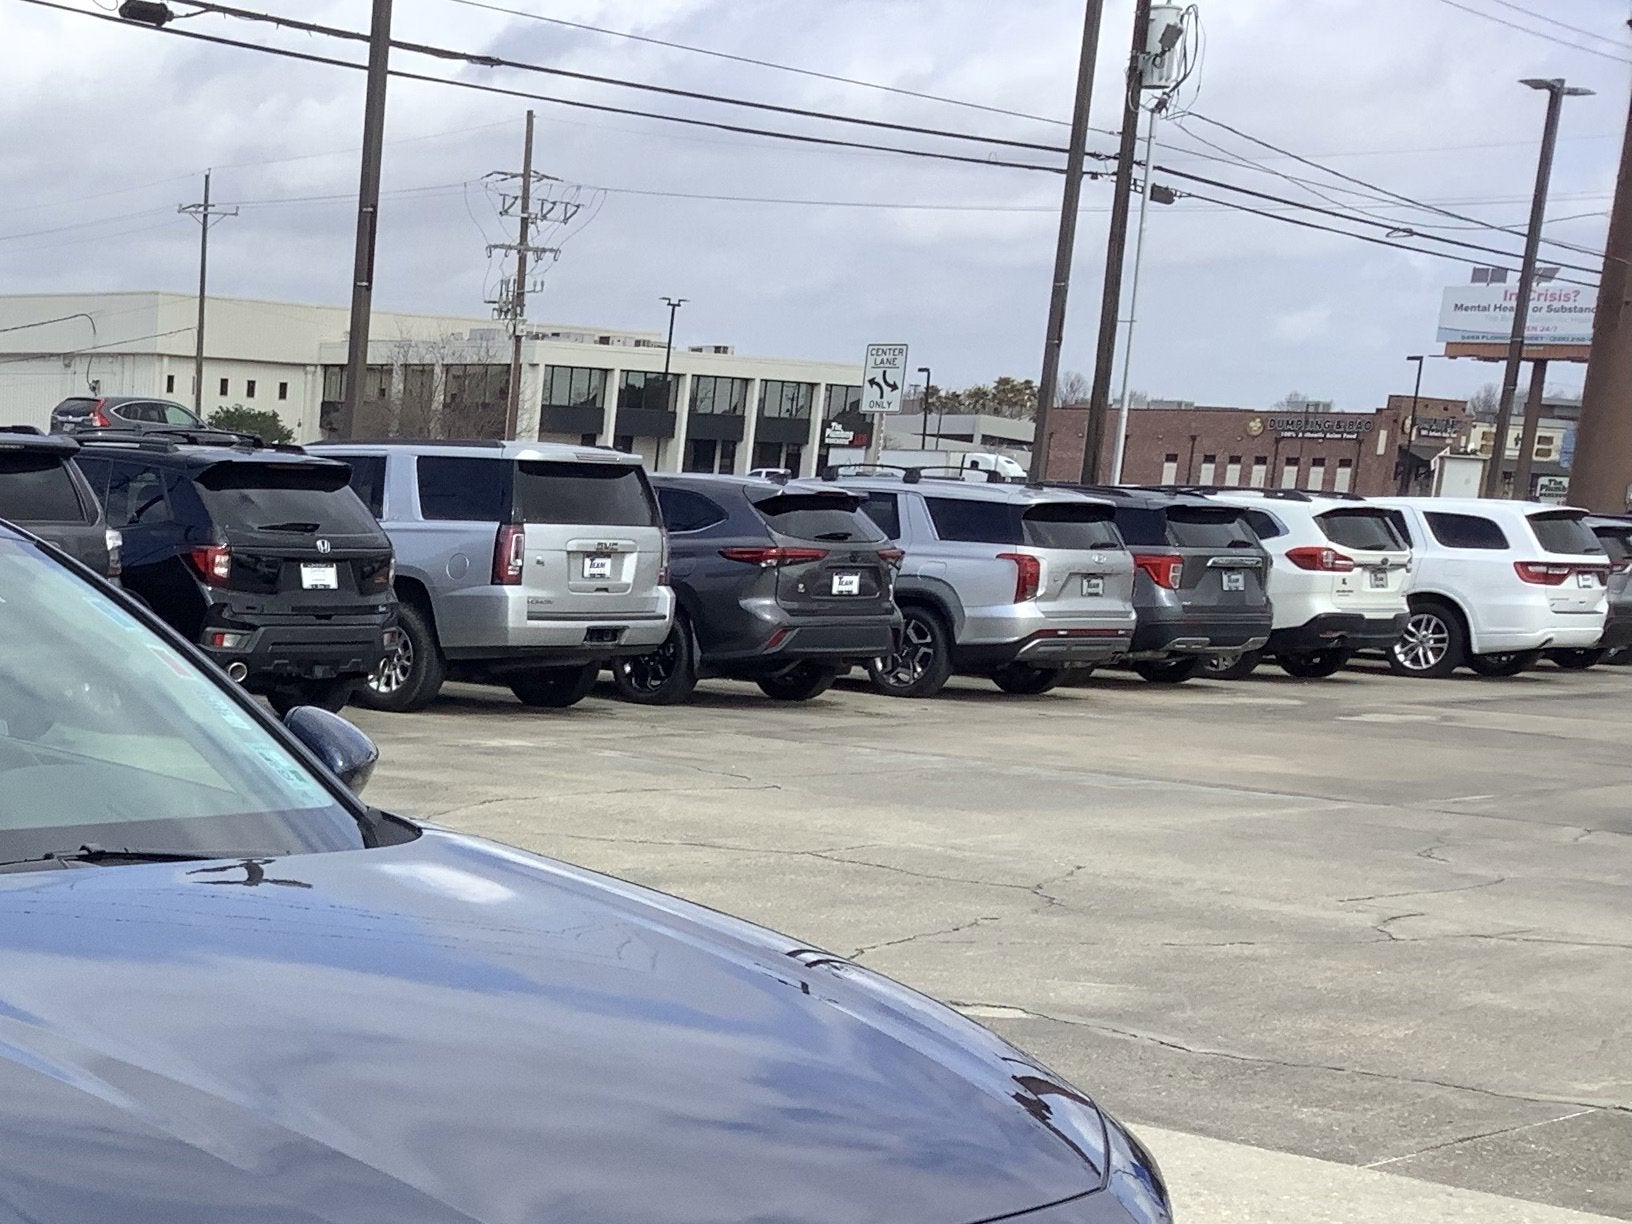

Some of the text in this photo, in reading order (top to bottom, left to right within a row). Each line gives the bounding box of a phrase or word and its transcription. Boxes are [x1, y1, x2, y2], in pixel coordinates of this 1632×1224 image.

[1453, 303, 1491, 312] Mental
[1532, 305, 1543, 313] or
[870, 347, 904, 357] CENTER
[874, 357, 898, 366] LANE
[869, 400, 892, 409] ONLY
